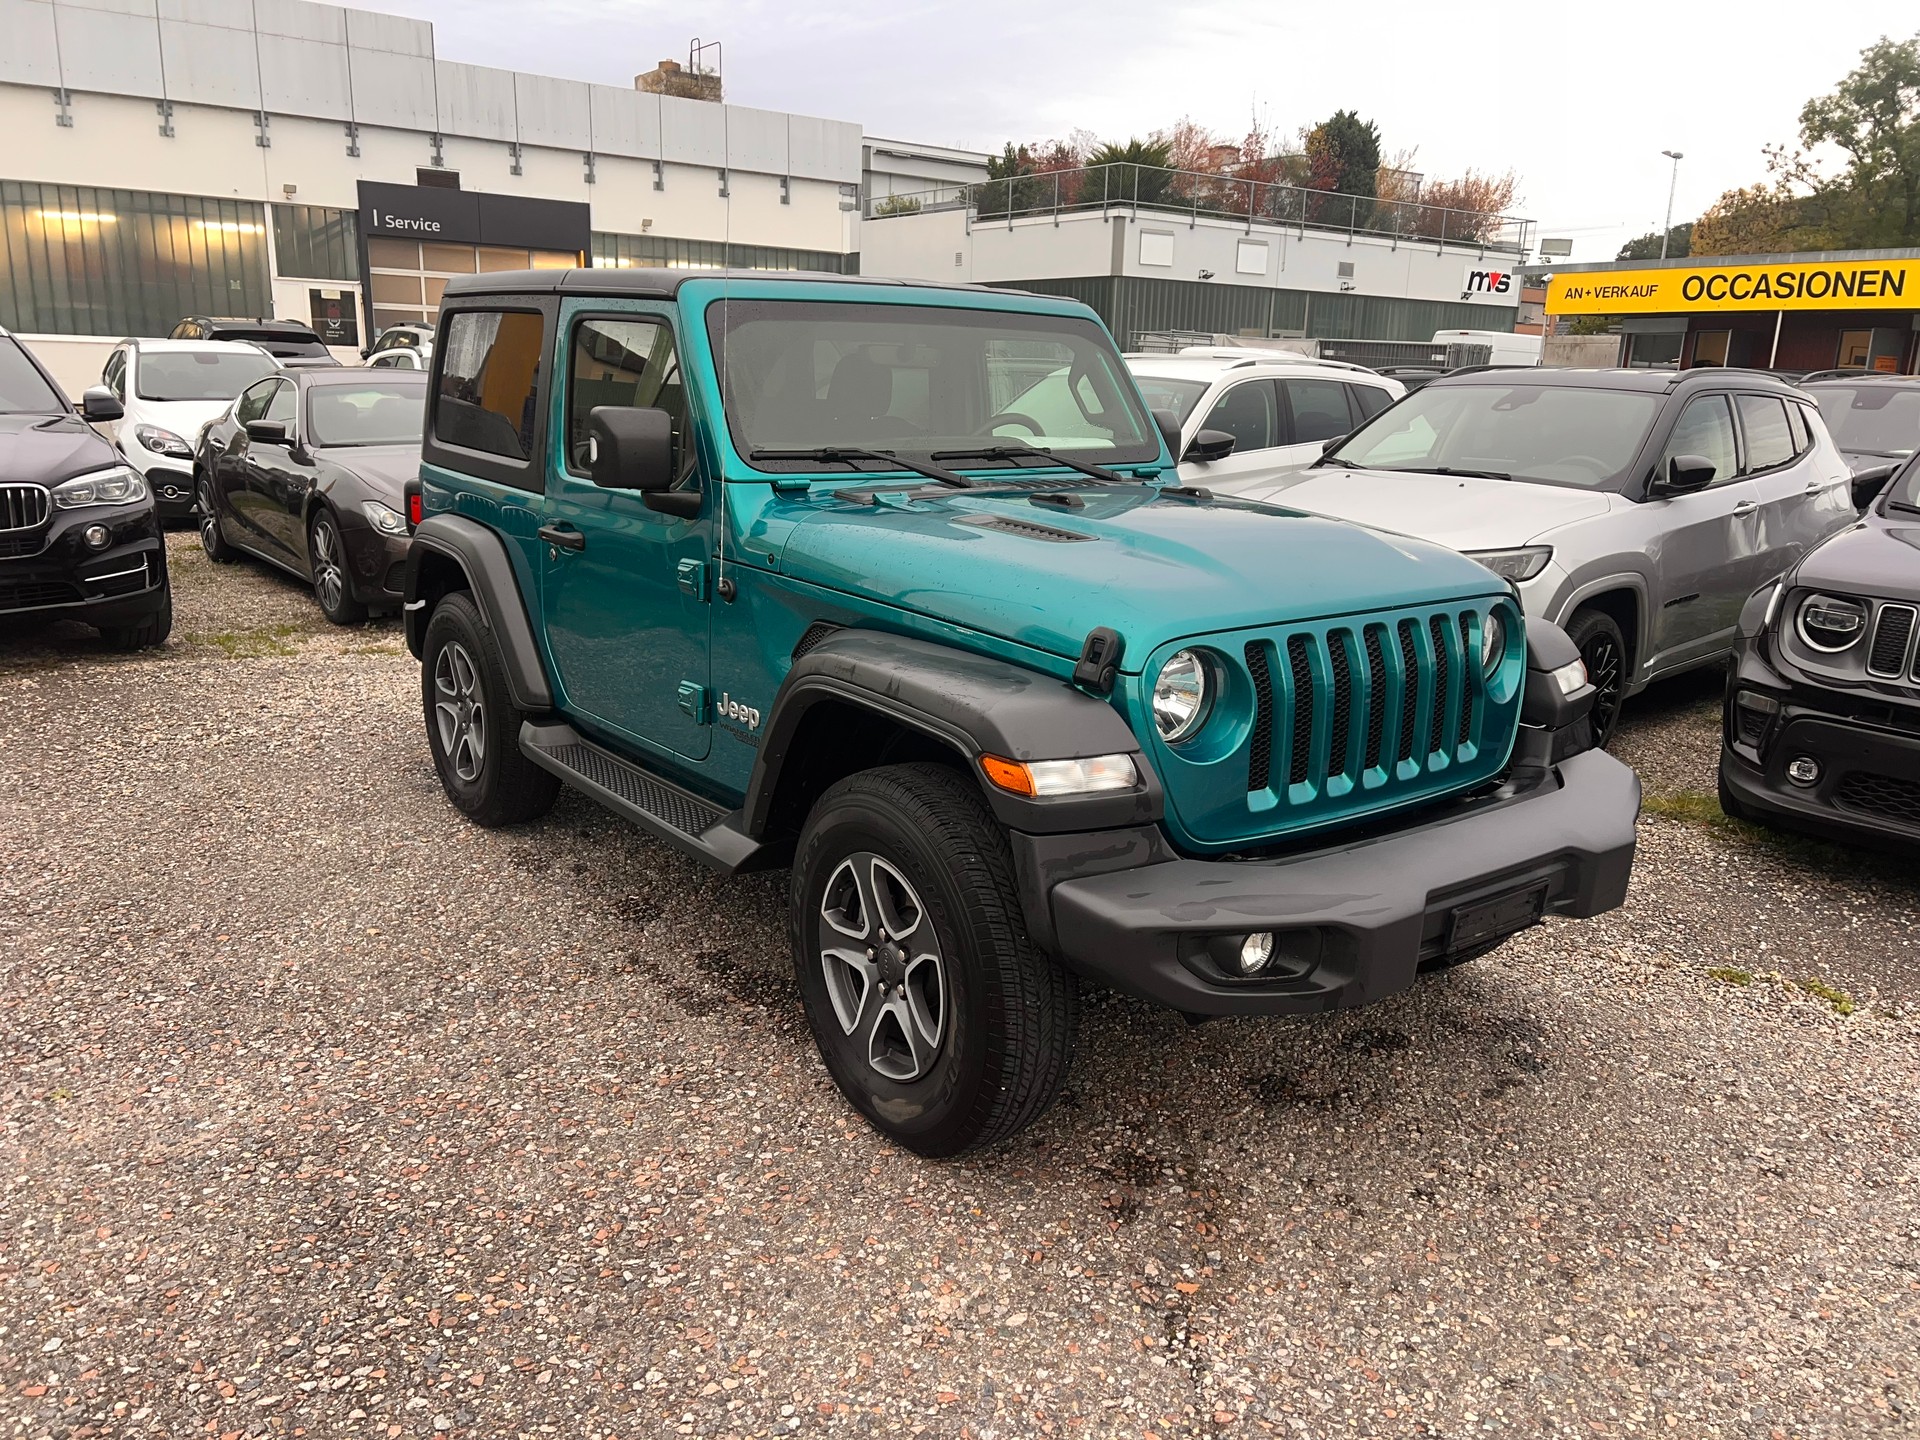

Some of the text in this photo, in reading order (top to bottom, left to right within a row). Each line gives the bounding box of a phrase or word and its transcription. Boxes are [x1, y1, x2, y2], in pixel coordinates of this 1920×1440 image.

[385, 215, 440, 232] Service
[1682, 269, 1906, 301] OCCASIONEN
[717, 692, 760, 731] Jeep
